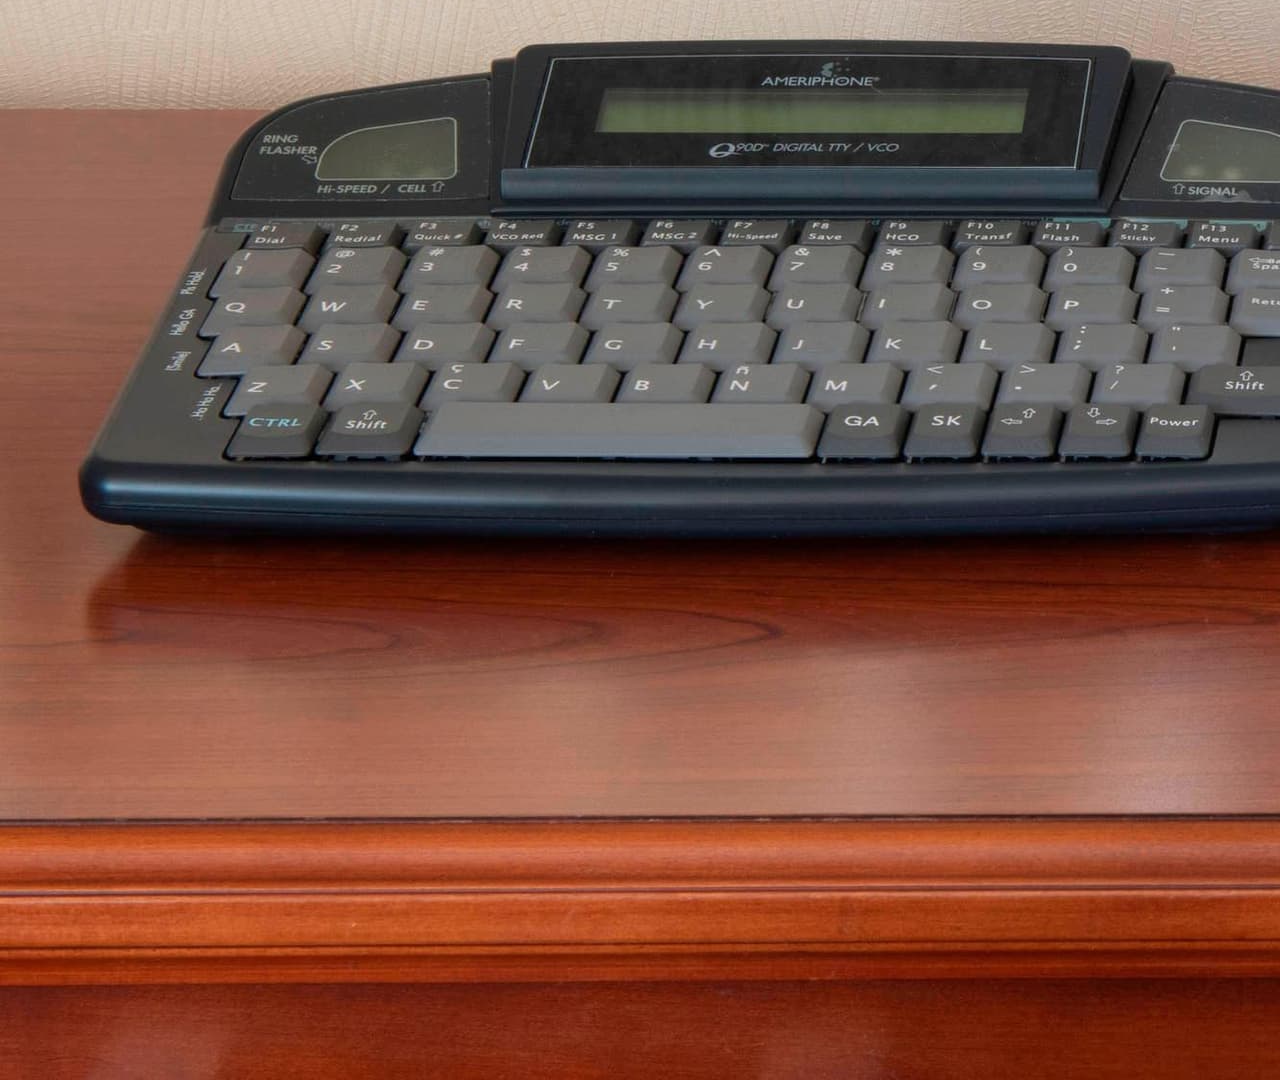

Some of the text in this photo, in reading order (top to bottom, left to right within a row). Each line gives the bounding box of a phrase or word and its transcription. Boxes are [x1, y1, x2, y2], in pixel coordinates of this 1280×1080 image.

[260, 146, 317, 154] FLASHER
[851, 143, 864, 152] /
[868, 143, 899, 152] VCO
[318, 185, 377, 193] Hi-SPEED
[1187, 186, 1238, 195] SIGNAL
[336, 250, 355, 258] @
[430, 248, 444, 256] #
[236, 266, 242, 274] 1
[327, 264, 341, 273] 2
[420, 263, 434, 271] 3
[514, 263, 528, 271] 4
[606, 263, 618, 271] 5
[699, 262, 712, 270] 6
[791, 262, 804, 270] 7
[881, 263, 894, 271] 8
[973, 262, 986, 270] 9
[225, 303, 245, 313] Q
[322, 302, 346, 312] W
[412, 300, 428, 310] E
[507, 299, 522, 309] R
[604, 299, 621, 309] T
[697, 300, 712, 309] Y
[787, 299, 804, 309] U
[972, 300, 991, 309] O
[1064, 301, 1079, 309] P
[222, 343, 240, 352] A
[318, 341, 332, 350] S
[414, 340, 433, 349] D
[509, 339, 524, 348] F
[605, 340, 622, 349] G
[698, 339, 717, 349] H
[792, 340, 803, 349] J
[886, 339, 901, 349] K
[980, 340, 992, 350] L
[1116, 366, 1124, 374] ?
[248, 382, 267, 392] Z
[346, 380, 365, 390] X
[444, 380, 462, 389] C
[543, 380, 559, 390] V
[635, 380, 649, 390] B
[730, 380, 749, 391] N
[825, 380, 847, 391] M
[1225, 380, 1264, 390] Shift
[250, 418, 300, 427] CTRL
[346, 418, 386, 428] Shift
[845, 416, 879, 426] GA
[932, 416, 960, 425] SK
[1151, 417, 1198, 426] Power
